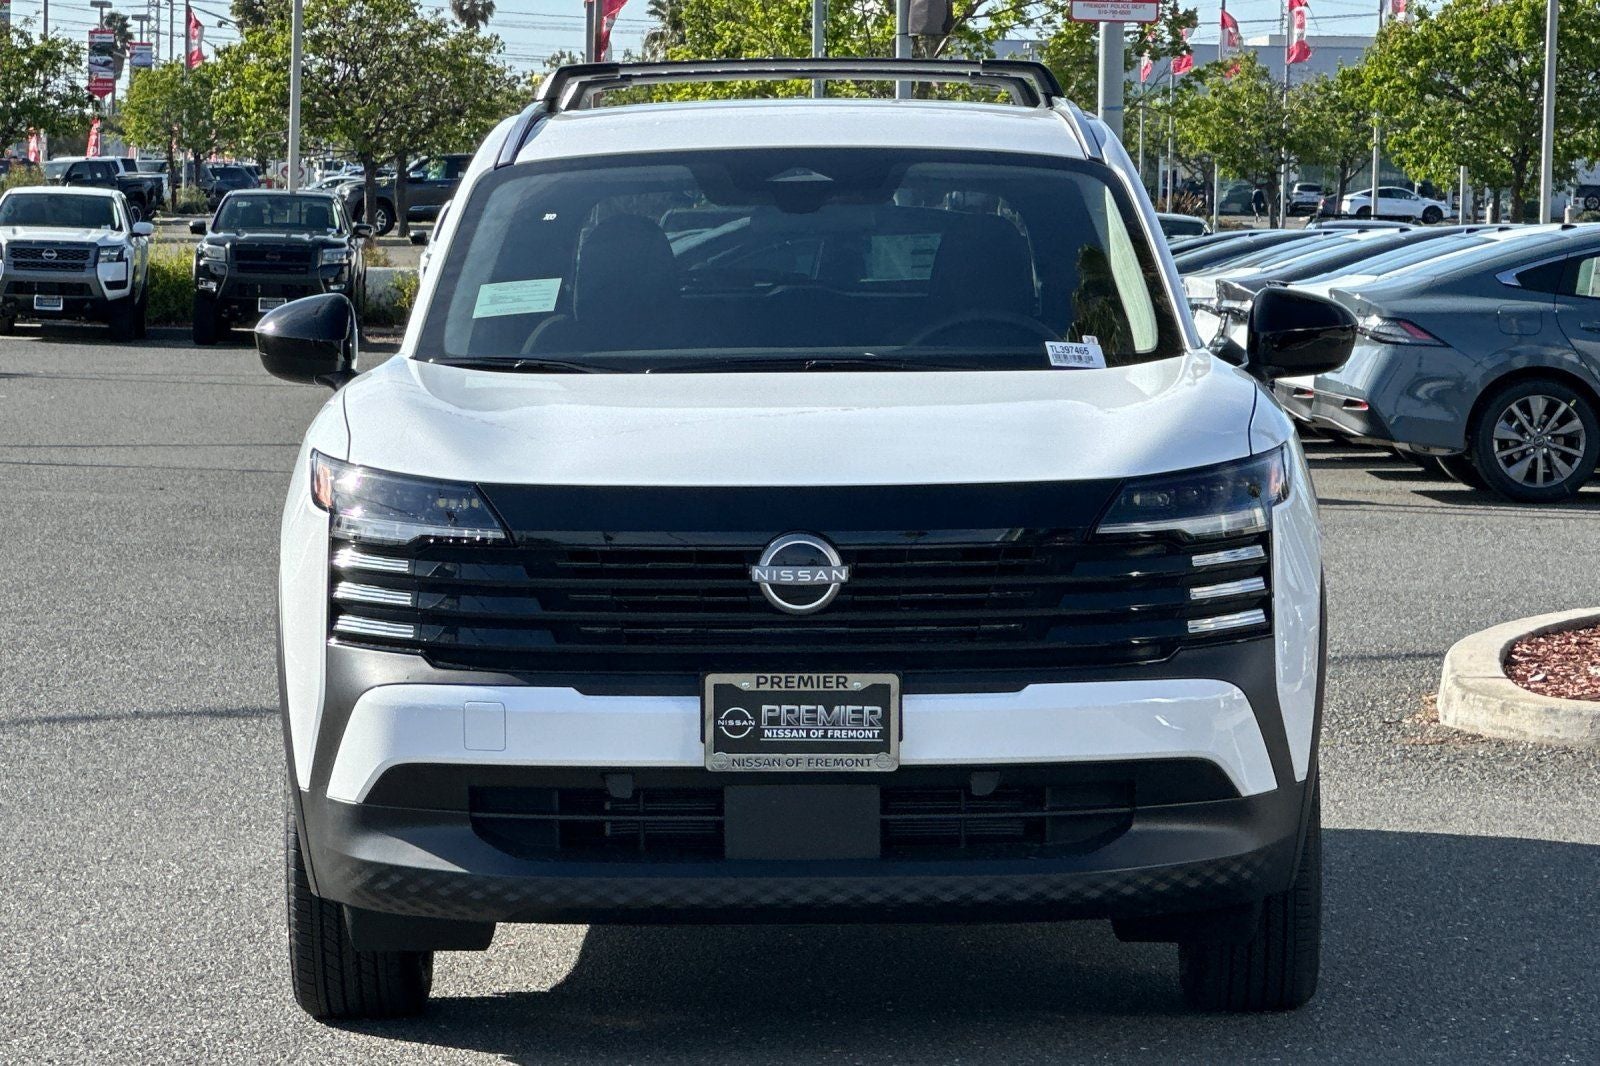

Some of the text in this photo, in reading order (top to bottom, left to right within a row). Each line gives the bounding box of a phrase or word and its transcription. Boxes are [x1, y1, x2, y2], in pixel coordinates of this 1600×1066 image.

[1049, 345, 1090, 355] TL397465
[754, 568, 846, 582] NISSAN
[755, 675, 849, 689] PREMIER
[761, 704, 883, 727] PREMIER
[764, 729, 880, 739] NISSAN OF FREMONT
[731, 757, 782, 768] NISSAN
[785, 757, 804, 768] OF
[807, 757, 873, 768] FREMONT
